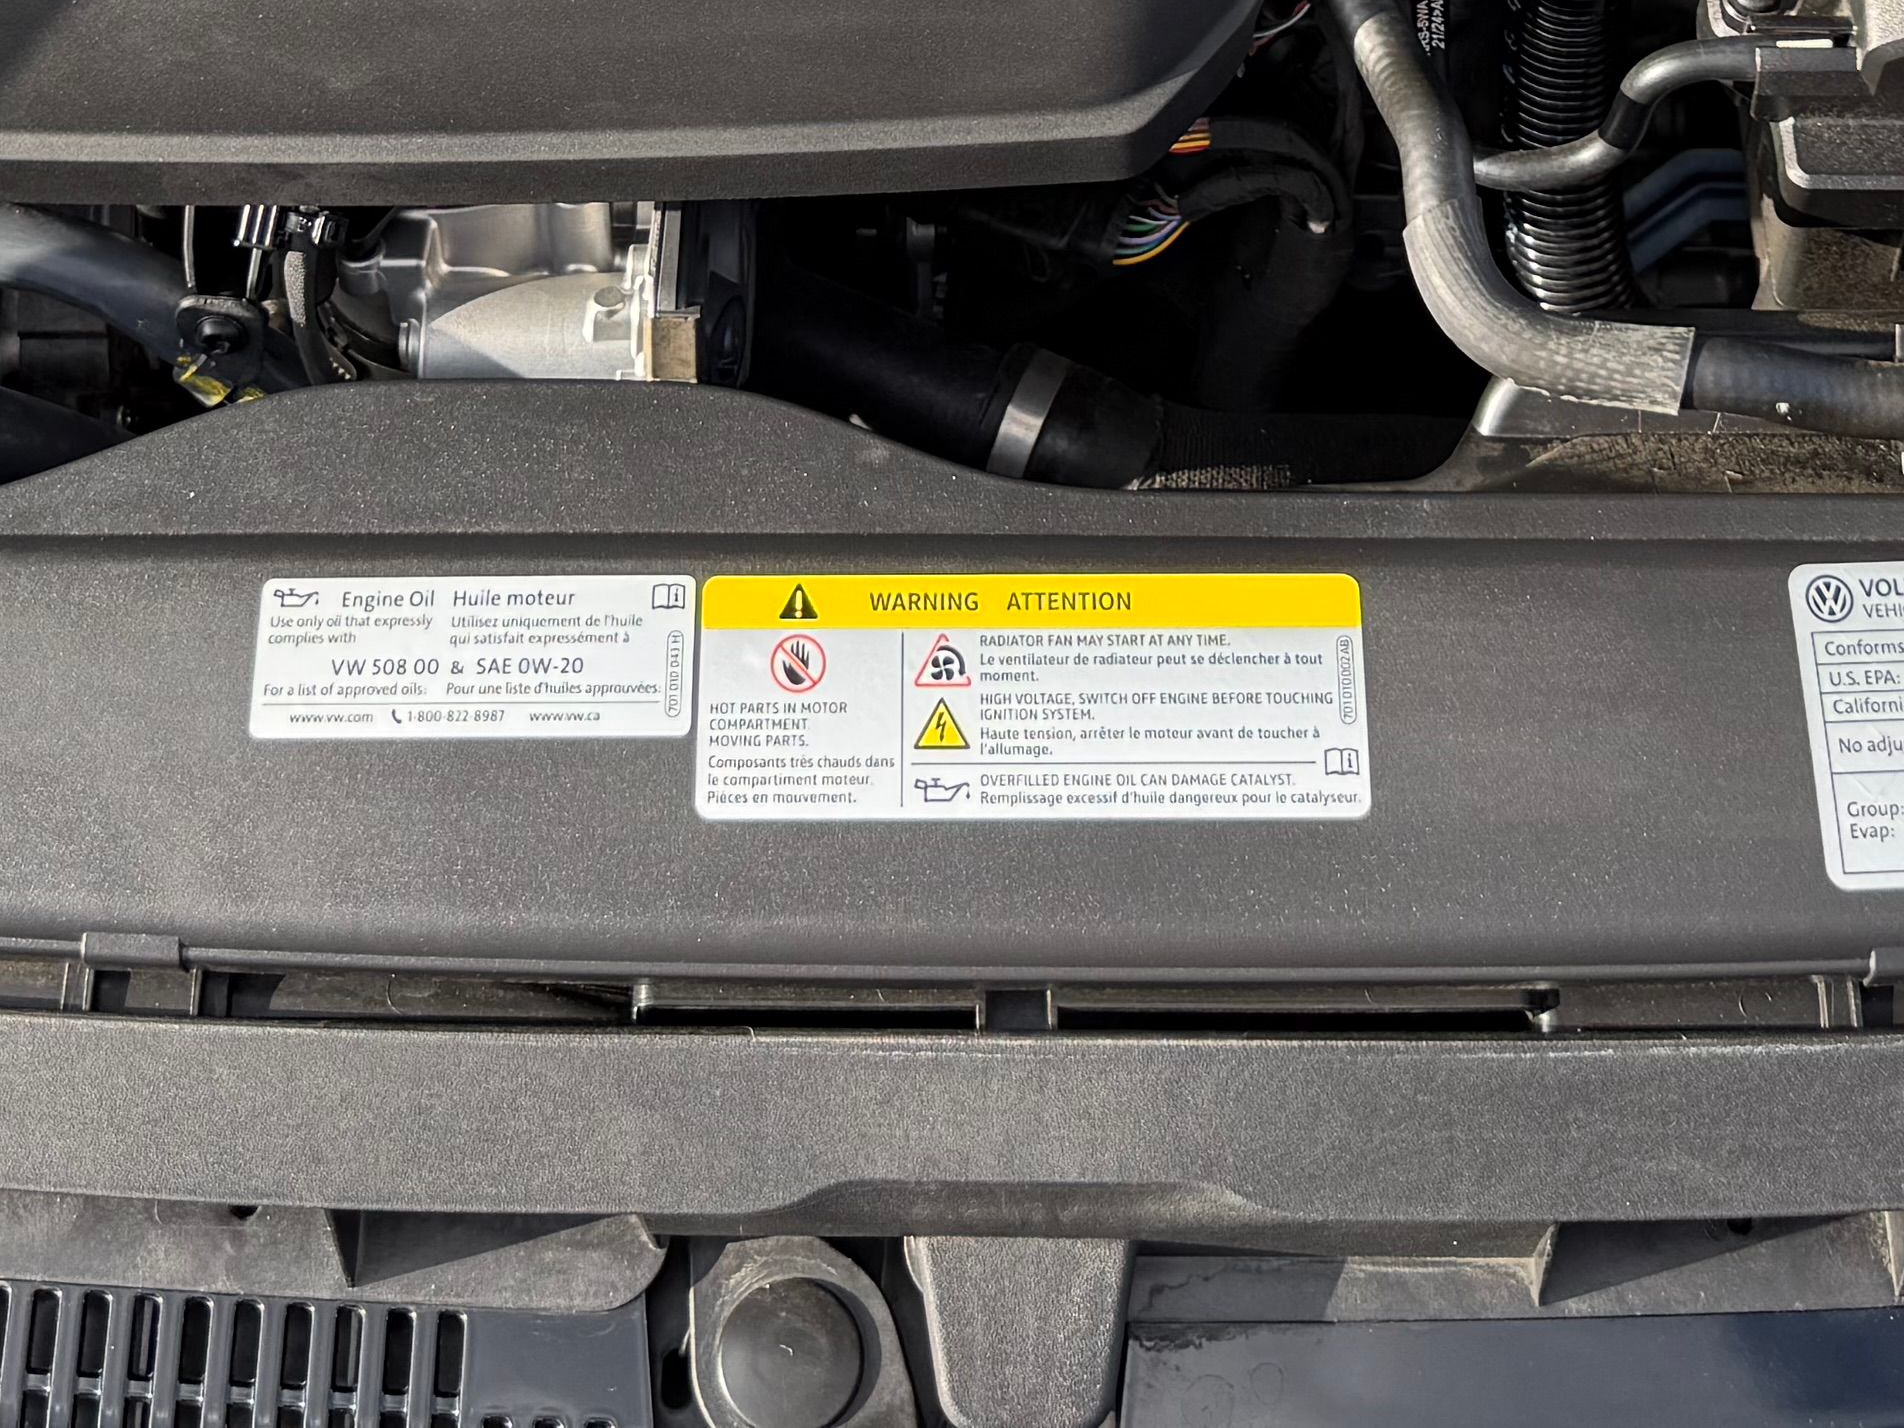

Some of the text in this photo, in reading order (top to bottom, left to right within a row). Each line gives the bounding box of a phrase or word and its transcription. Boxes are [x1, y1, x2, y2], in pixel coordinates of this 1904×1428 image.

[341, 589, 436, 613] Engine Oil
[453, 588, 576, 607] Huile moteur
[869, 591, 1131, 612] WARNING ATTENTION
[979, 633, 1231, 648] RADIATOR FAN MAY START AT ANY TIME.
[331, 658, 367, 677] VW
[371, 658, 407, 676] 508
[413, 658, 440, 675] 00
[450, 660, 465, 675] &
[476, 657, 512, 675] SAE
[979, 651, 1323, 669] Le ventilateur de radiateur peut se déclencher à tout
[979, 670, 1040, 682] moment.
[1828, 669, 1901, 687] U.S. EPA:
[980, 692, 1012, 706] HIGH
[1078, 692, 1128, 706] SWITCH
[1131, 692, 1157, 705] OFF
[1159, 691, 1208, 705] ENGINE
[1211, 691, 1263, 705] BEFORE
[1265, 691, 1334, 705] TOUCHING
[709, 701, 848, 715] HOT PARTS IN MOTOR
[980, 707, 1095, 721] IGNITION SYSTEM.
[708, 734, 809, 748] MOVING PARTS.
[980, 726, 1020, 741] Haute
[1023, 726, 1077, 742] tension,
[1128, 725, 1141, 740] le
[1144, 728, 1193, 740] moteur
[1196, 727, 1234, 740] avant
[1237, 725, 1254, 740] de
[1257, 725, 1309, 740] toucher
[1312, 725, 1321, 739] à
[1838, 737, 1863, 754] No
[708, 754, 787, 771] Composants
[816, 754, 862, 769] chauds
[864, 754, 895, 768] dans
[707, 772, 719, 786] le
[722, 774, 818, 789] compartiment
[980, 773, 1060, 787] OVERFILLED
[1063, 773, 1112, 787] ENGINE
[1115, 773, 1137, 787] OIL
[1140, 772, 1168, 787] CAN
[1171, 772, 1227, 787] DAMAGE
[751, 793, 769, 804] en
[772, 791, 857, 804] mouvement.
[980, 790, 1063, 808] Remplissage
[1066, 790, 1118, 805] excessif
[1121, 790, 1166, 804] d'huile
[1168, 790, 1239, 808] dangereux
[1241, 793, 1272, 807] pour
[1275, 790, 1288, 804] le
[1846, 800, 1904, 821] Group:
[1849, 822, 1895, 843] Evap:
